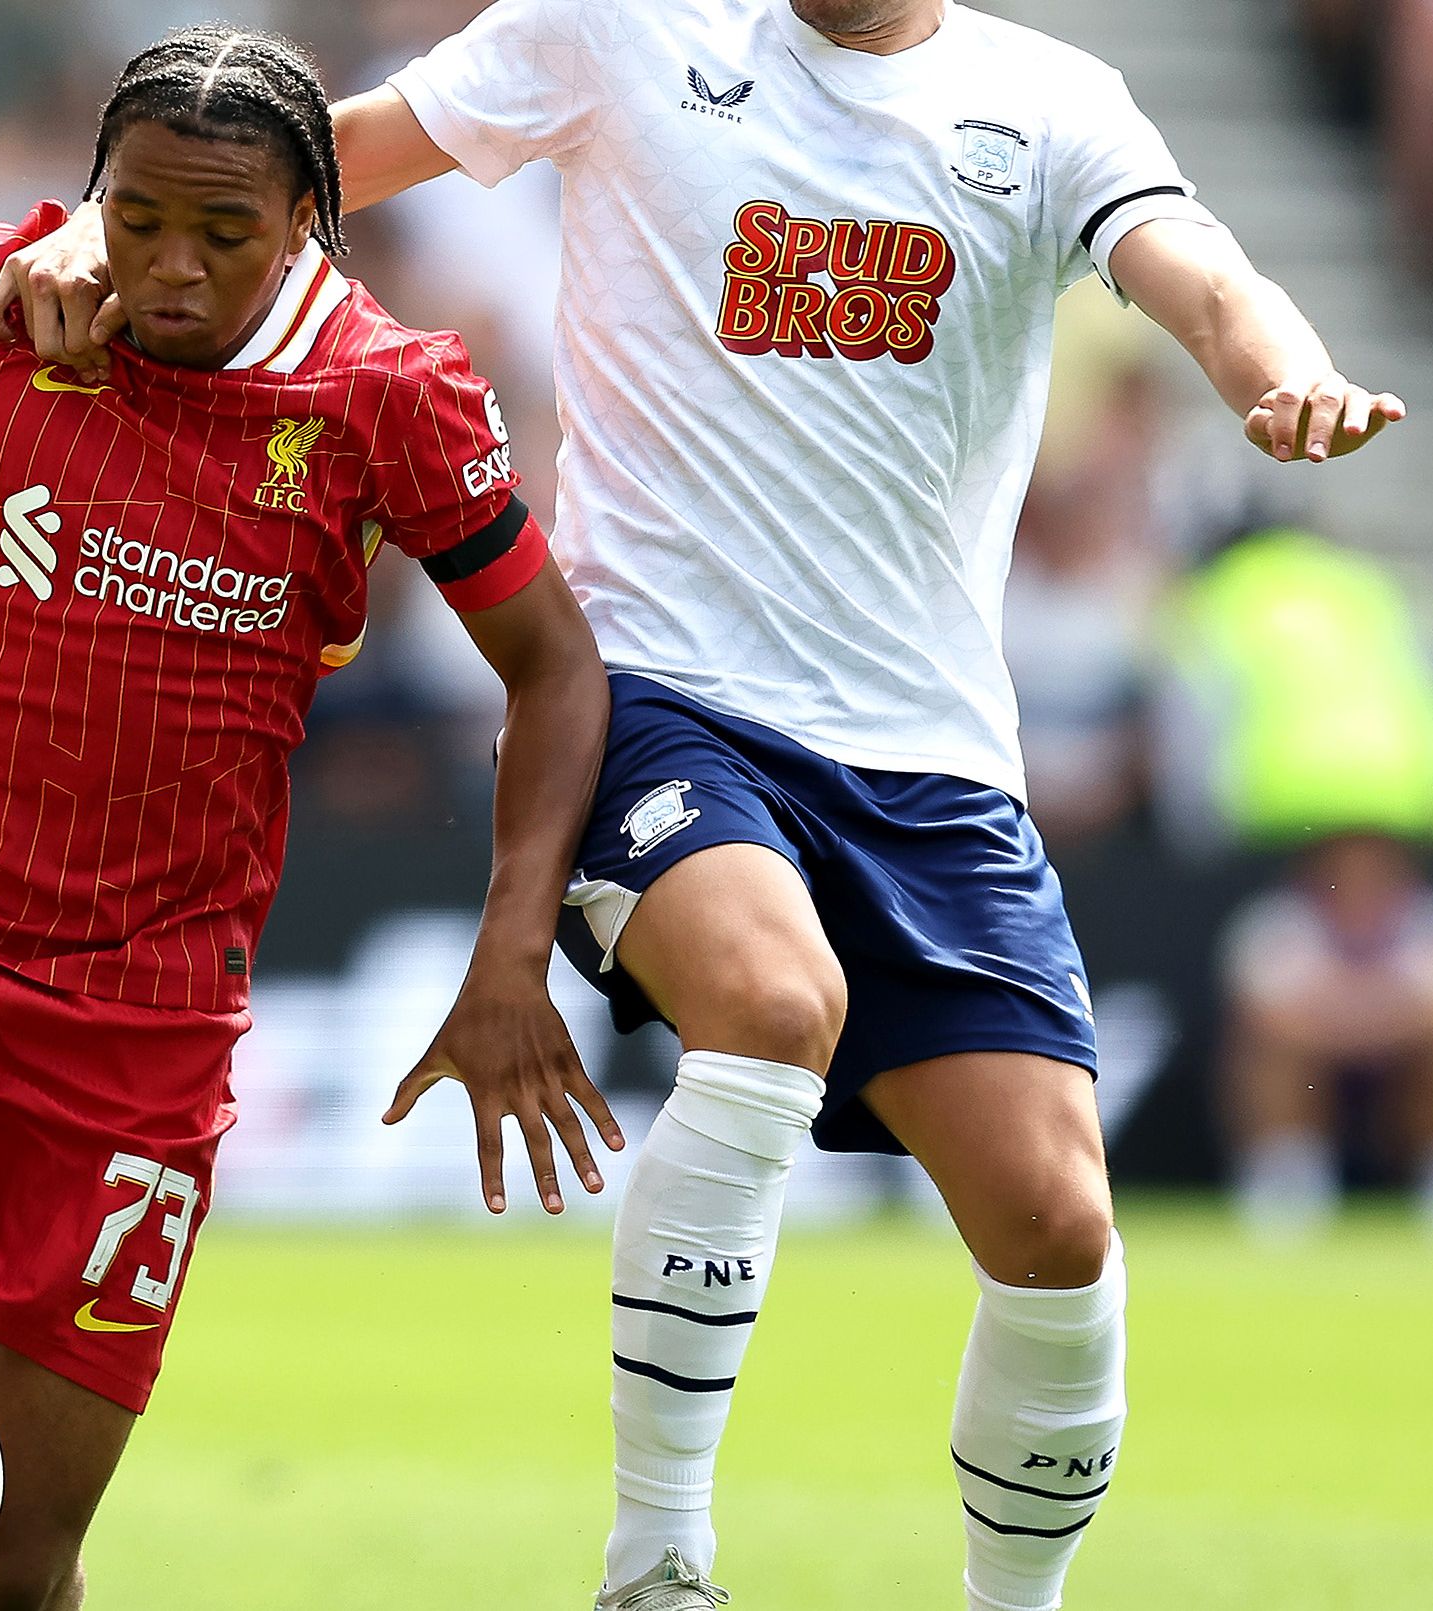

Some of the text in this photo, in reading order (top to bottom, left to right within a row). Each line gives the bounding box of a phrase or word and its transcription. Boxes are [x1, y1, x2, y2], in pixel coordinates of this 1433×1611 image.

[680, 100, 743, 124] CASTORE
[977, 169, 994, 181] PP
[724, 199, 956, 297] SPUD
[716, 271, 941, 365] BROS
[252, 487, 309, 514] L.F.C.
[80, 526, 293, 603] standard
[74, 564, 288, 633] chartered
[81, 1151, 200, 1313] 73
[662, 1254, 756, 1288] PNE
[1020, 1446, 1116, 1478] PNE
